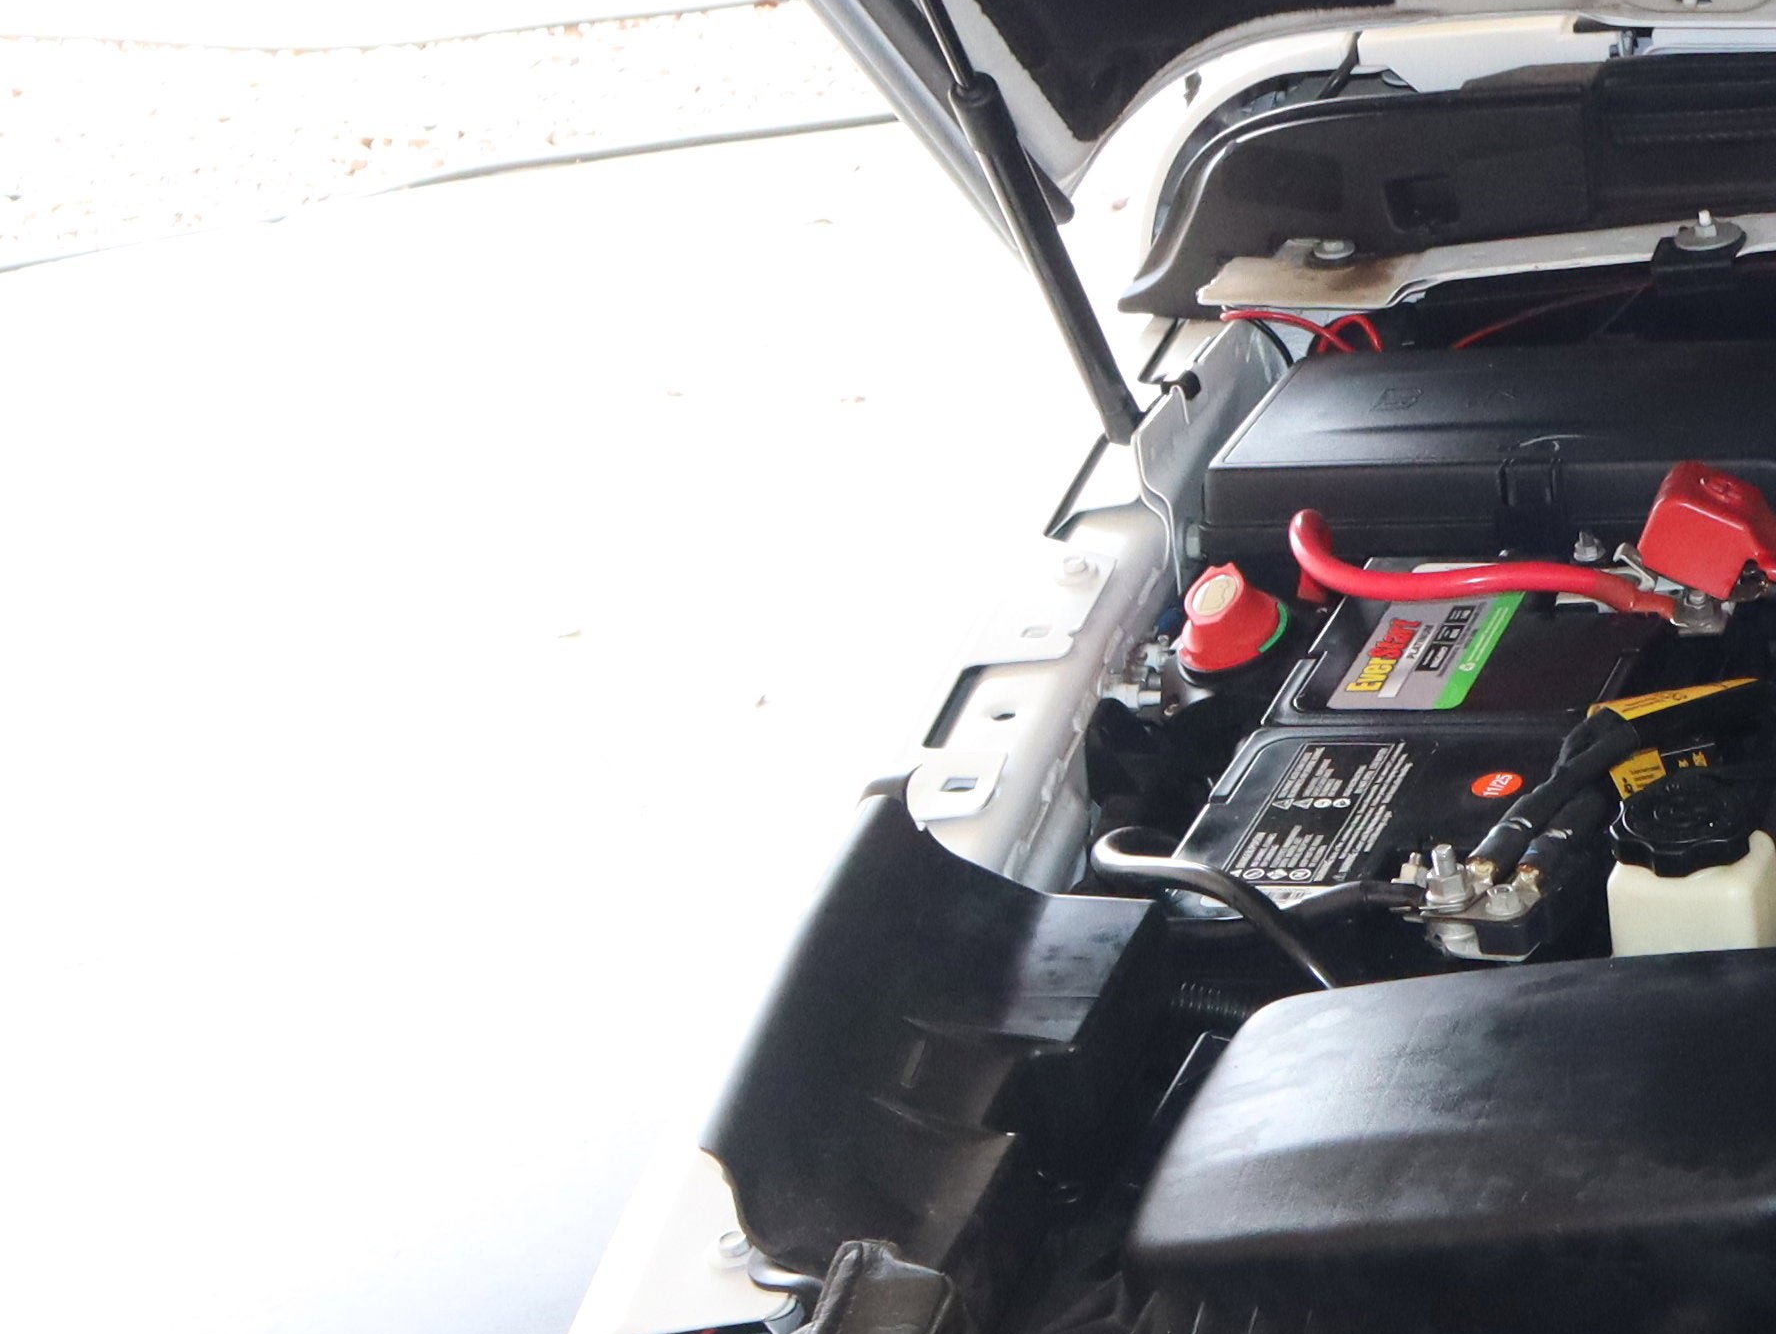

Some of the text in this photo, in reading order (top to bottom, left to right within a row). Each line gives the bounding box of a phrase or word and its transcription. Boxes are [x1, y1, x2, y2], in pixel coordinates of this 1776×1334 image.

[1345, 617, 1422, 693] EverStart
[1406, 624, 1435, 661] PLATINUM
[1482, 774, 1514, 796] 11/25
